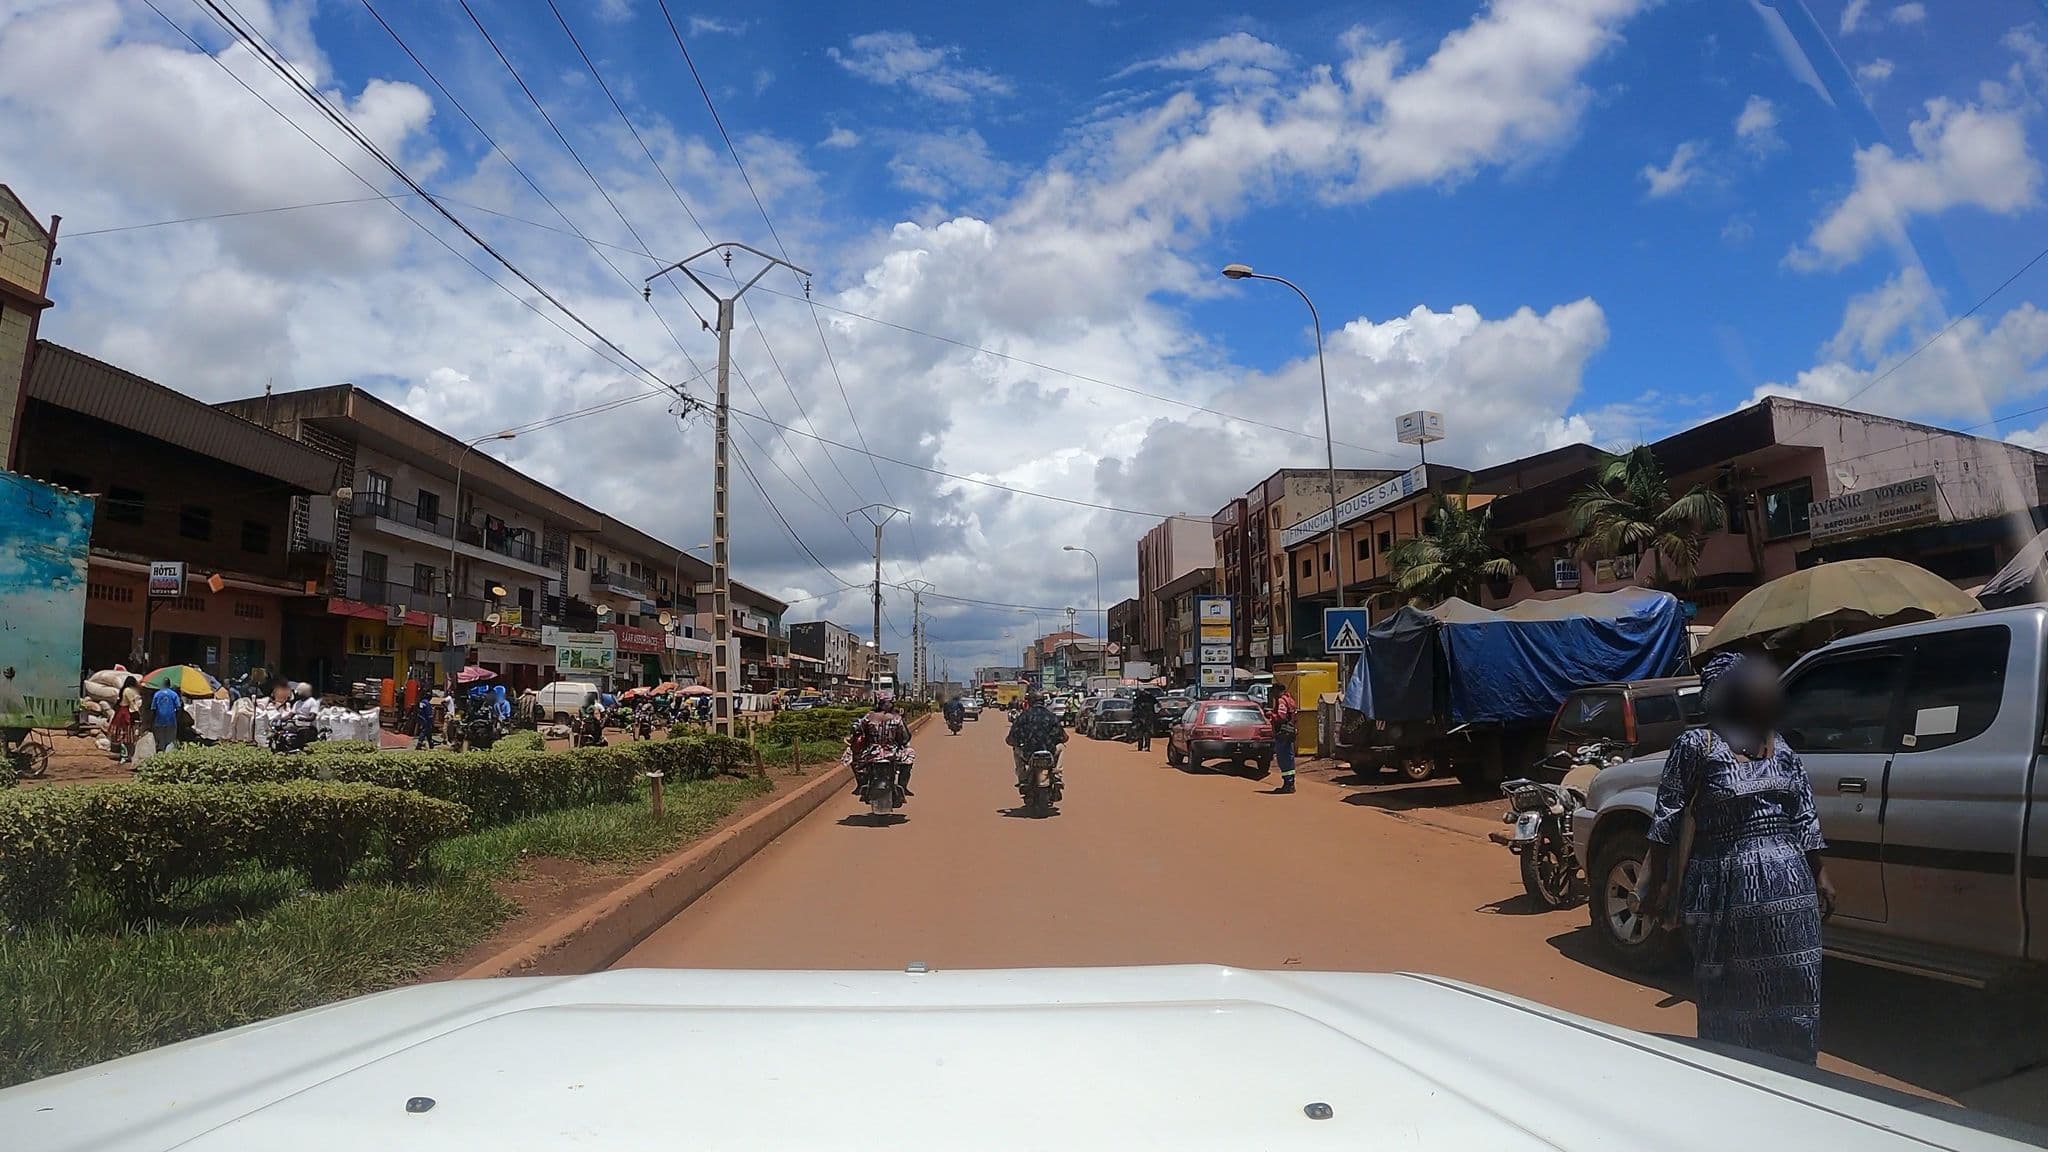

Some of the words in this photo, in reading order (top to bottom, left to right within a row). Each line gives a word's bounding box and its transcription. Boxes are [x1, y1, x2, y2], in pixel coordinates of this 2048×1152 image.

[1289, 513, 1334, 540] FINANCIAL
[1337, 491, 1376, 518] HOUSE
[1378, 483, 1399, 499] S.A
[1810, 493, 1862, 518] AVENIR
[1874, 480, 1929, 501] VOYAGES
[1823, 513, 1871, 530] BAFOUSSAM
[1878, 503, 1922, 519] FOUMBAN
[153, 564, 178, 576] HÔTEL
